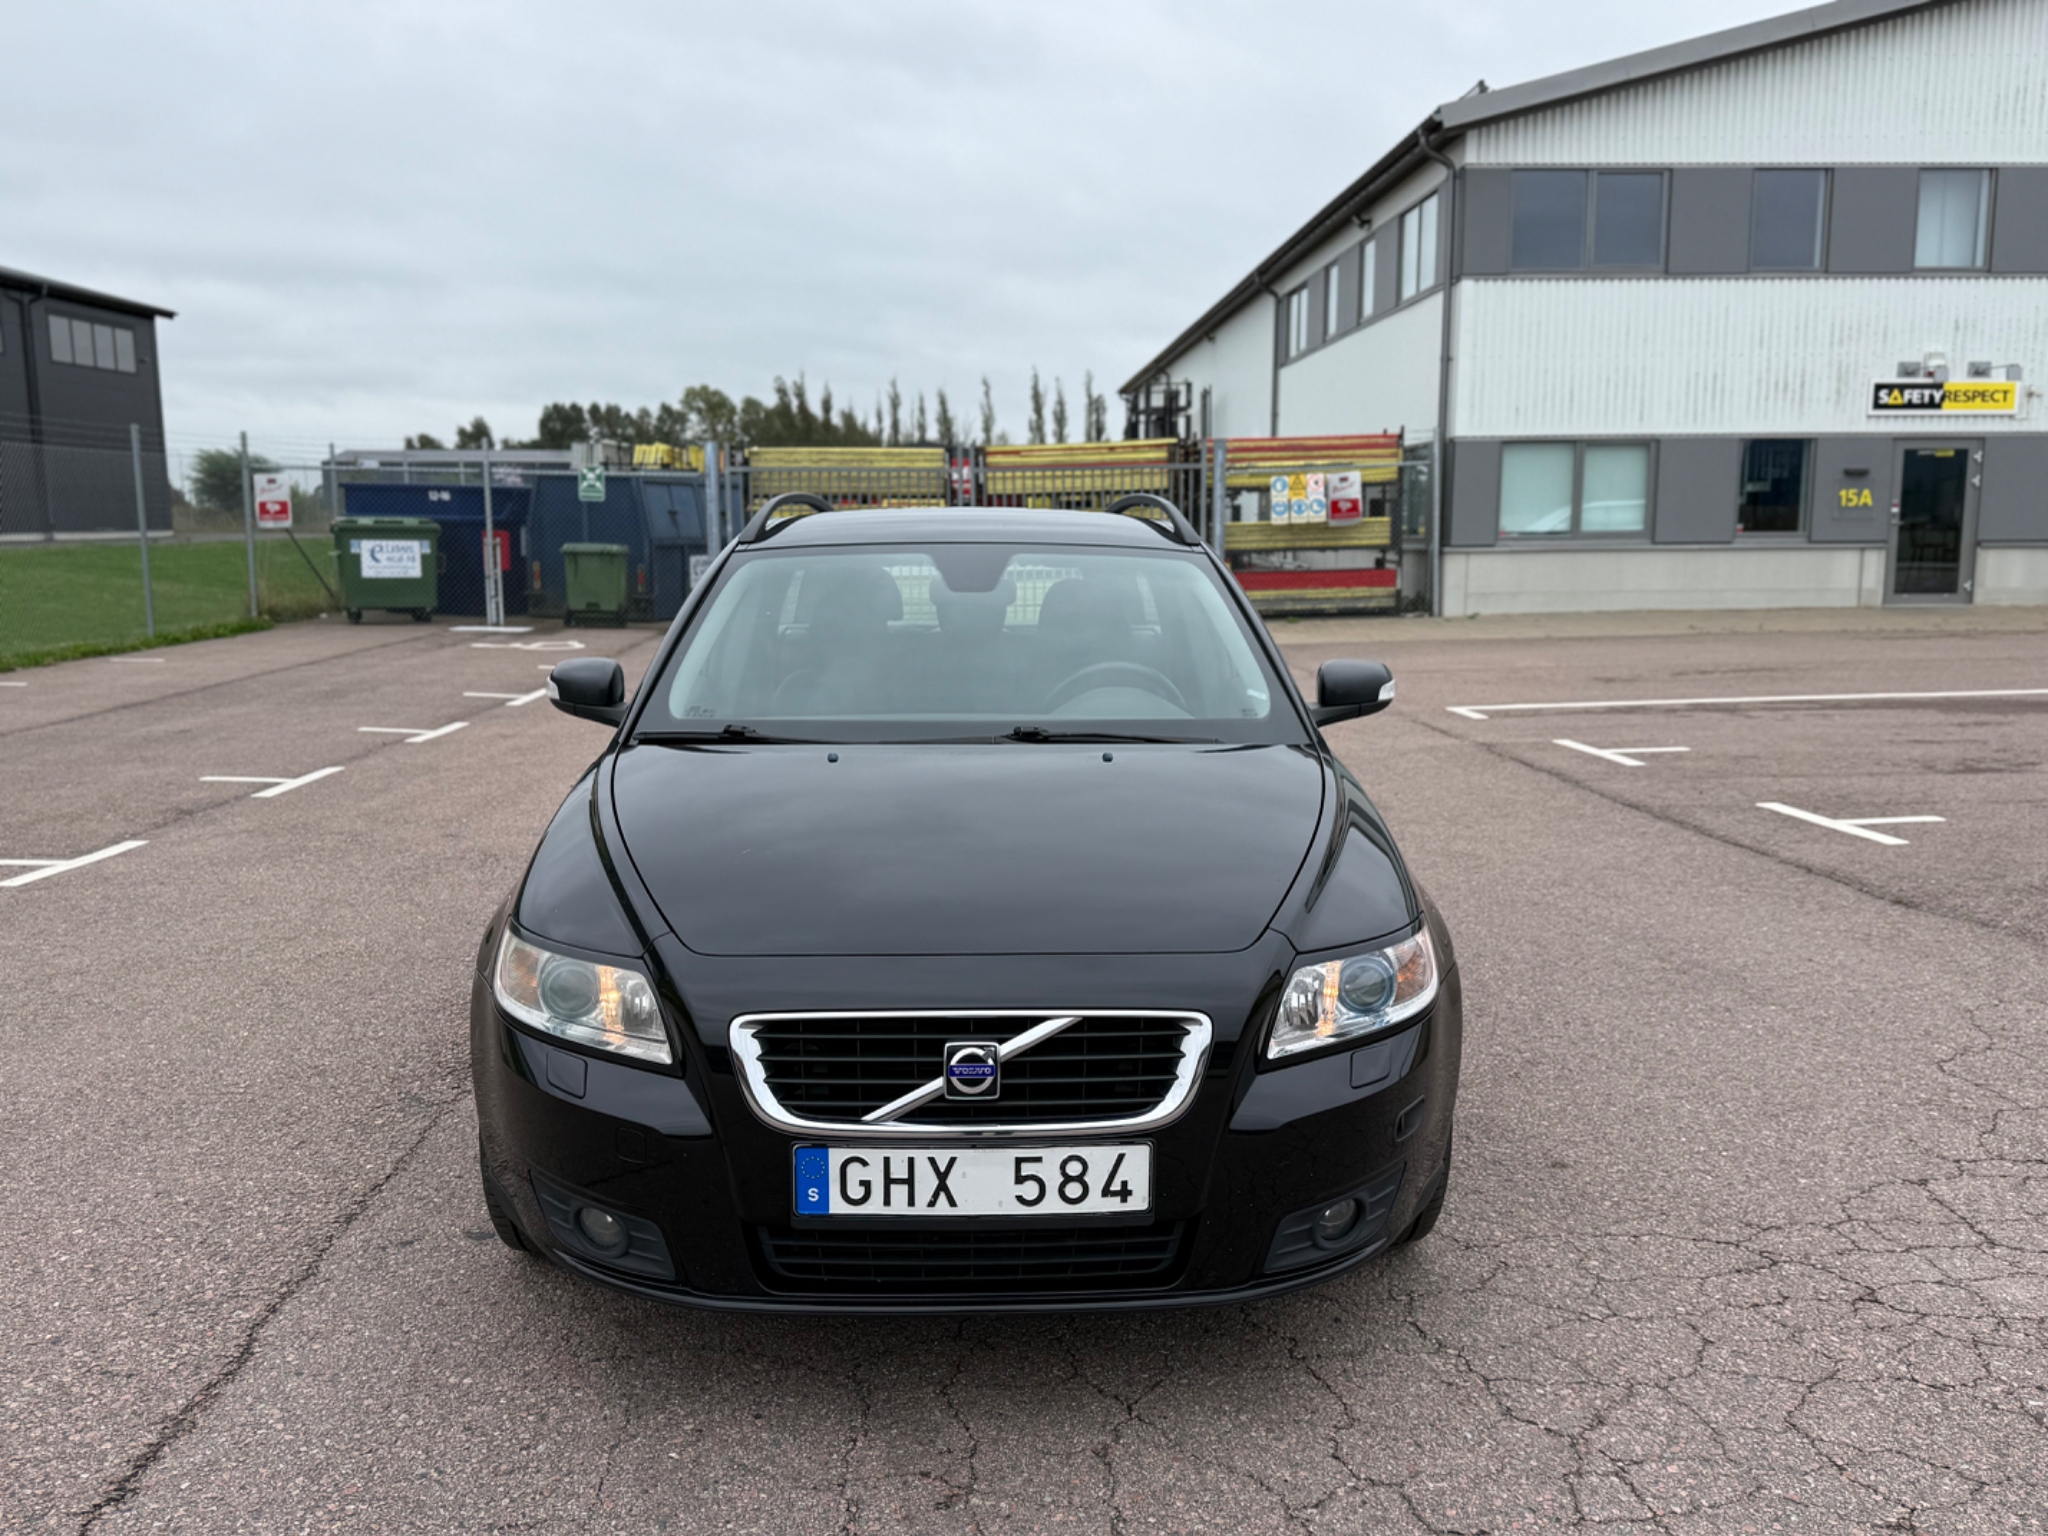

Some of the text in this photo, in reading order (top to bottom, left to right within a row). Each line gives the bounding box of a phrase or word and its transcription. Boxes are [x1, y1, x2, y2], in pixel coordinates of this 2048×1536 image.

[1839, 489, 1873, 507] 15A
[951, 1067, 992, 1075] VOLVO
[839, 1153, 1133, 1208] GHX 584
[807, 1187, 820, 1202] S
